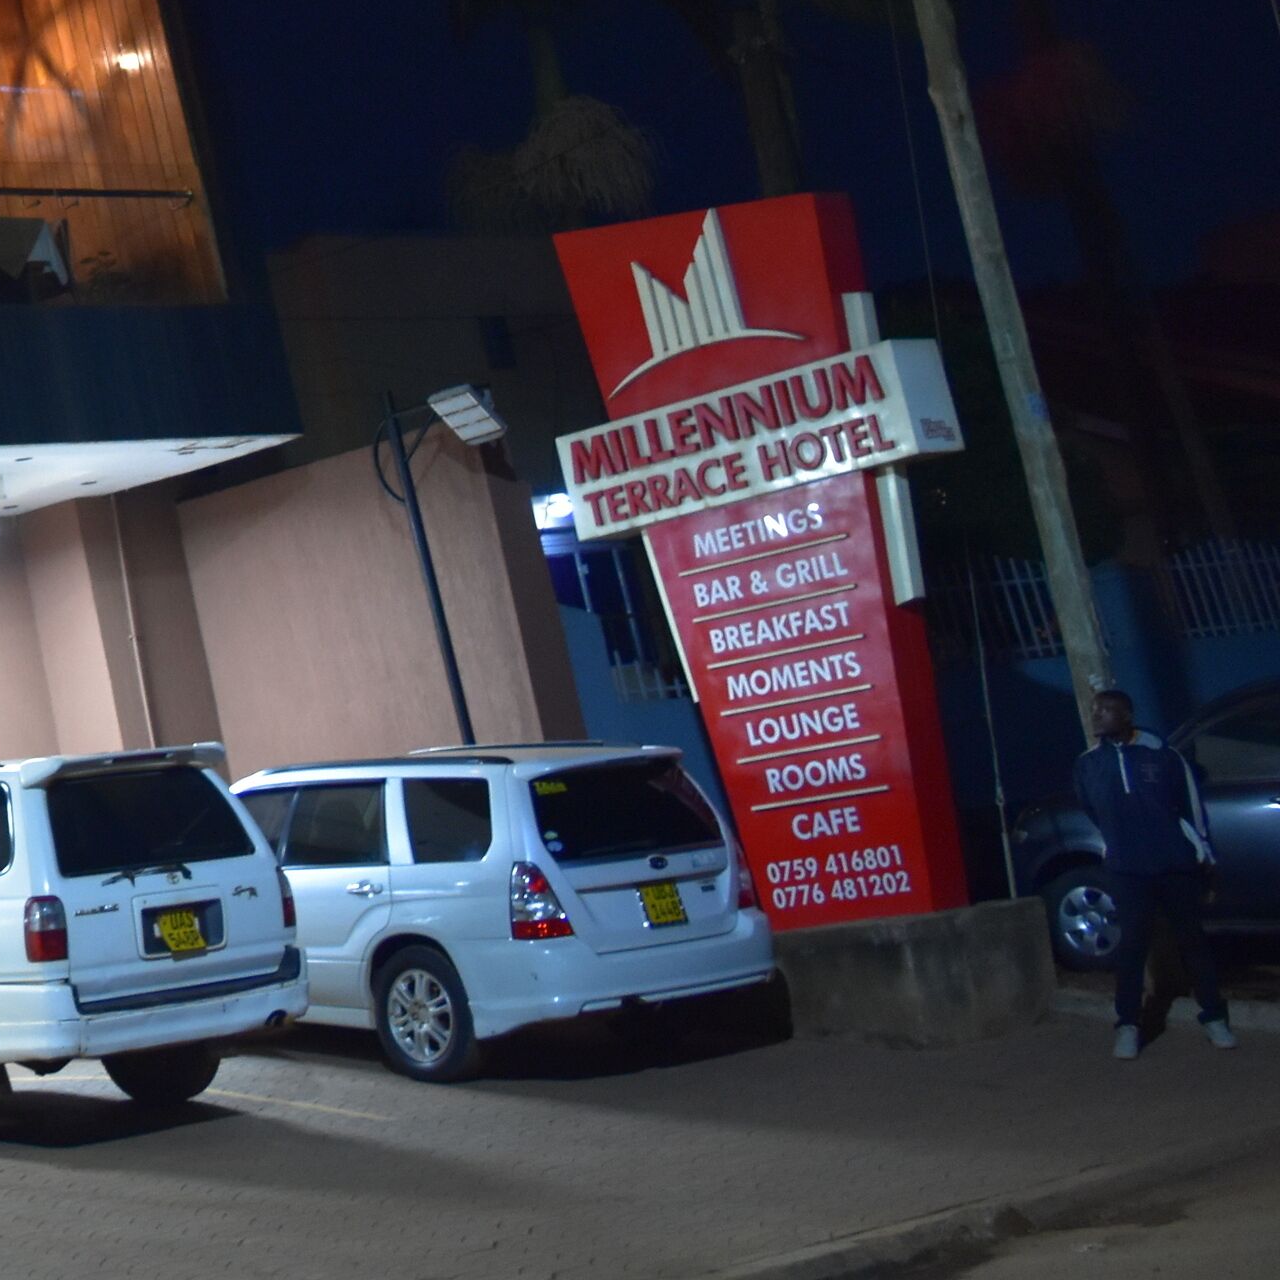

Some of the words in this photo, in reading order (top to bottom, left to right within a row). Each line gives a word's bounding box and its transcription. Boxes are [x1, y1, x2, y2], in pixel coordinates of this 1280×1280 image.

[569, 355, 886, 484] MILLENNIUM
[583, 453, 750, 527] TERRACE
[758, 414, 895, 480] HOTEL
[693, 503, 824, 558] MEETINGS
[692, 574, 742, 608] BAR
[750, 570, 769, 594] &
[776, 552, 848, 589] GRILL
[708, 602, 849, 654] BREAKFAST
[726, 651, 861, 701] MOMENTS
[745, 703, 860, 747] LOUNGE
[765, 753, 867, 794] ROOMS
[792, 806, 861, 841] CAFE
[766, 859, 818, 884] 0759
[825, 845, 902, 875] 416801
[772, 884, 825, 909] 0776
[831, 871, 911, 901] 481202
